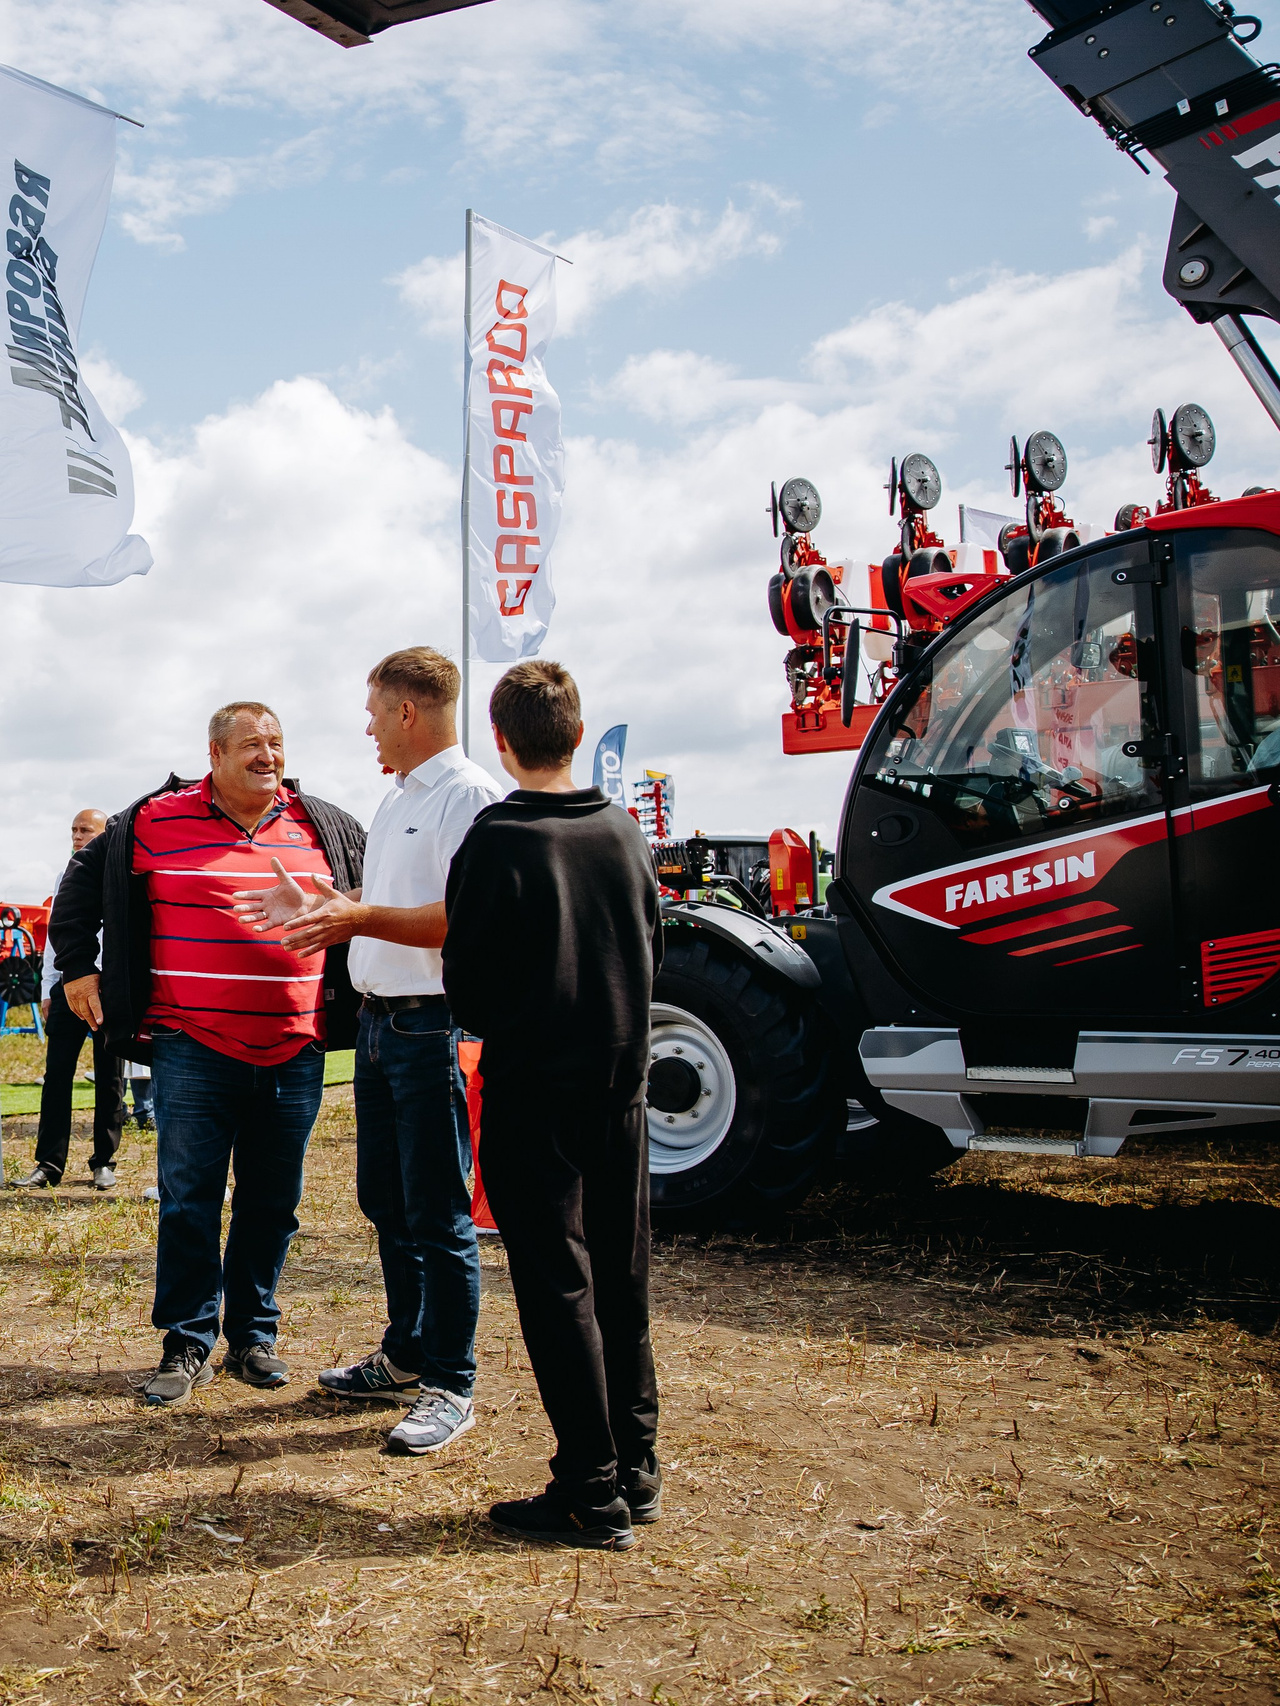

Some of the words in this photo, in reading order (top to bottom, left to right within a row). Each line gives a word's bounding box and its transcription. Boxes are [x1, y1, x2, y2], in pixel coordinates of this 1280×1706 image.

[485, 279, 540, 616] GASPARDO
[945, 850, 1095, 912] FARESIN
[361, 1365, 391, 1389] N
[437, 1403, 463, 1431] N
